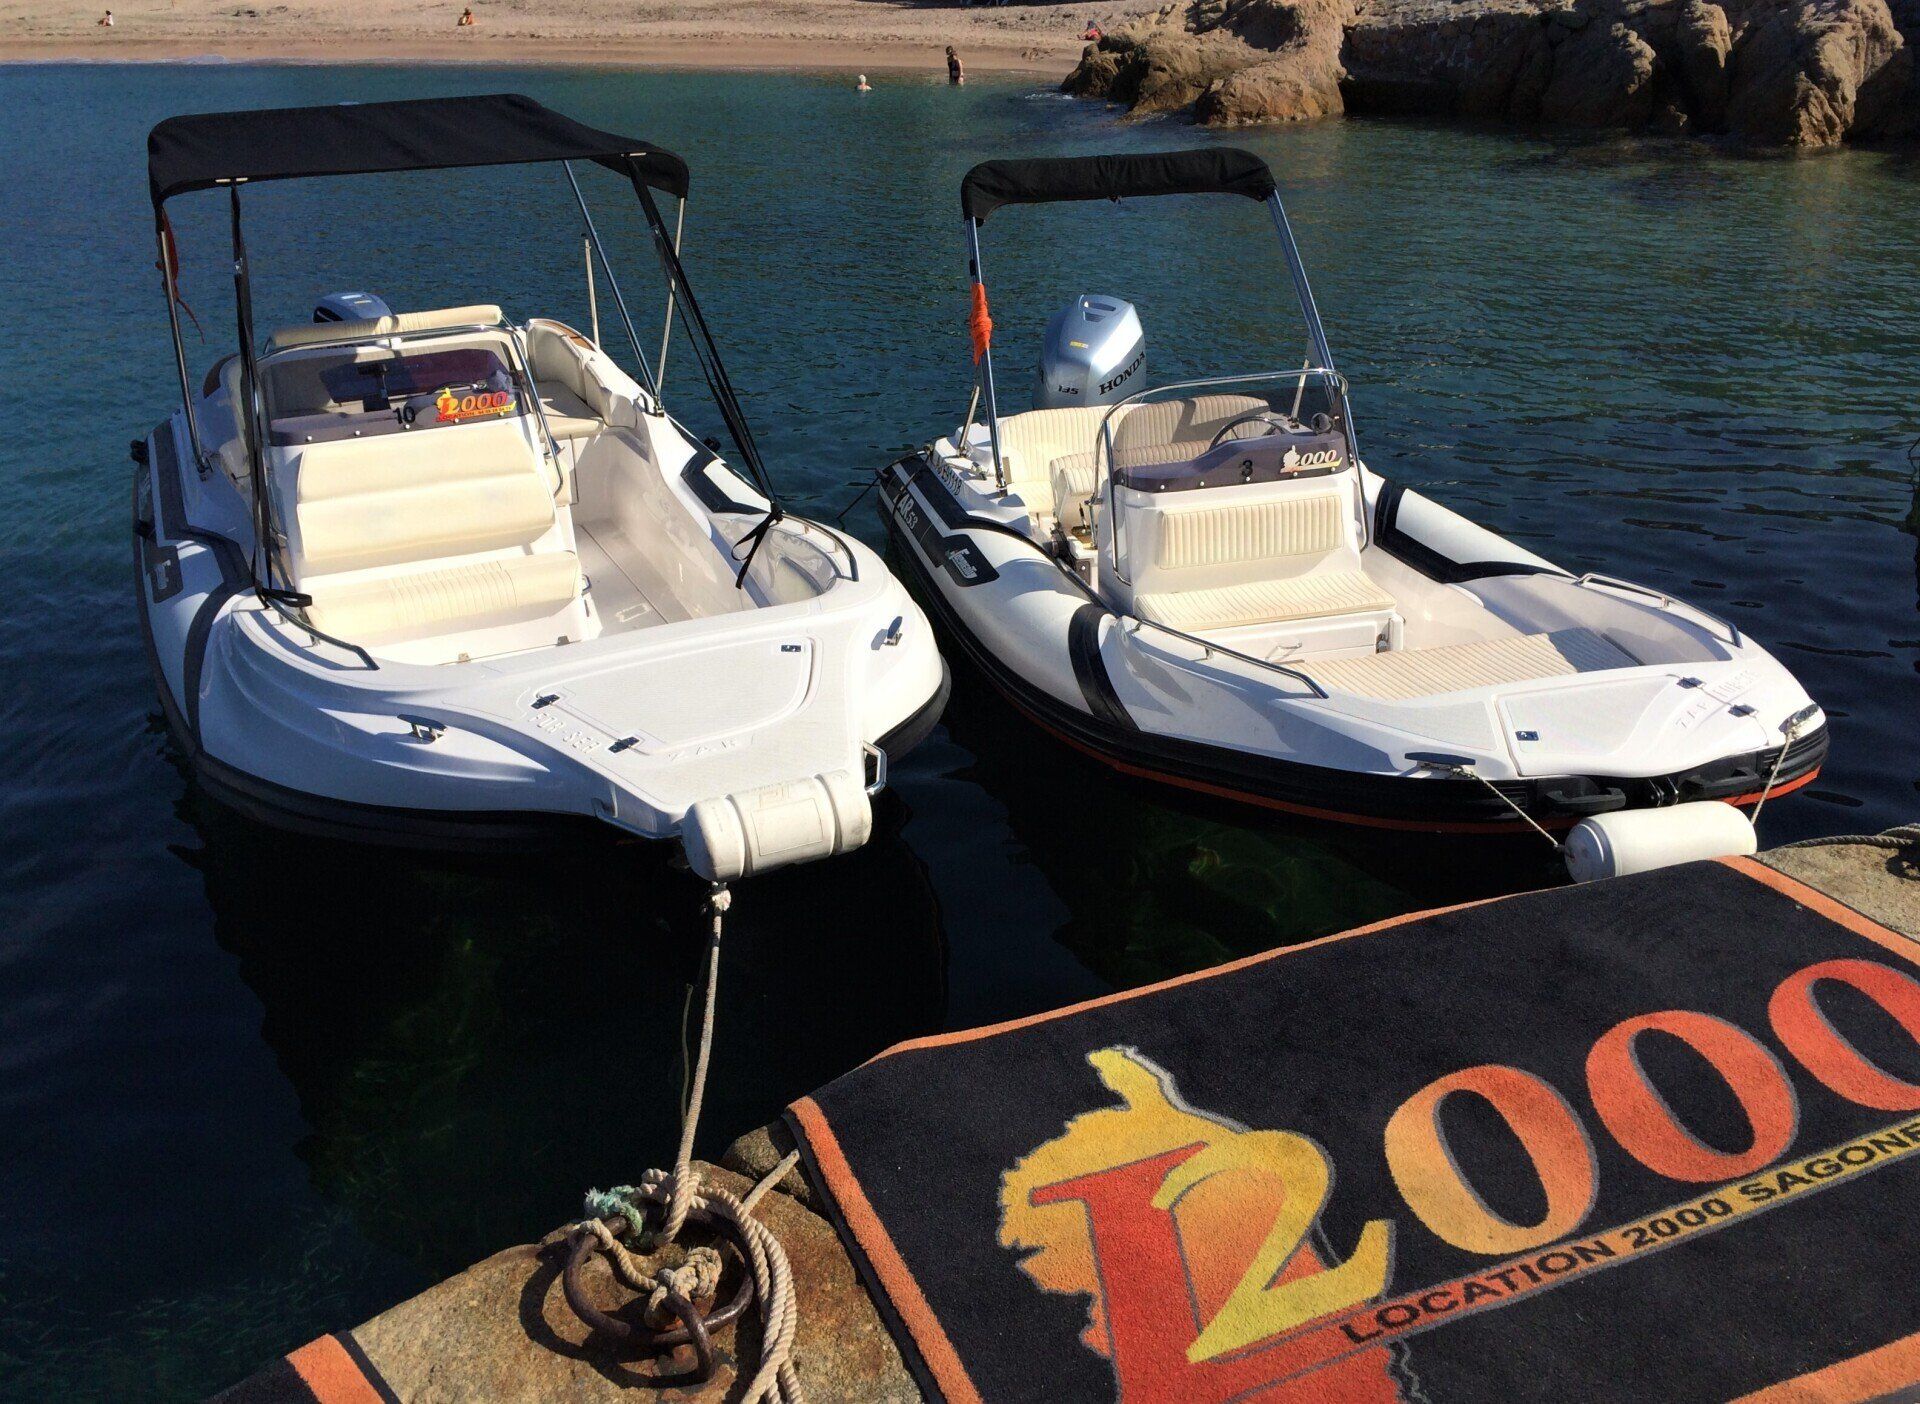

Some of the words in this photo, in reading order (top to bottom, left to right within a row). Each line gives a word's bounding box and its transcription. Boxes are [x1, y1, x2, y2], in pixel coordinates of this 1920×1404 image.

[1099, 351, 1145, 396] HONDA
[1058, 384, 1079, 395] 135
[393, 405, 416, 424] 10
[1241, 459, 1254, 476] 3
[1338, 1240, 1617, 1346] LOCATION
[1621, 1198, 1733, 1251] 2000
